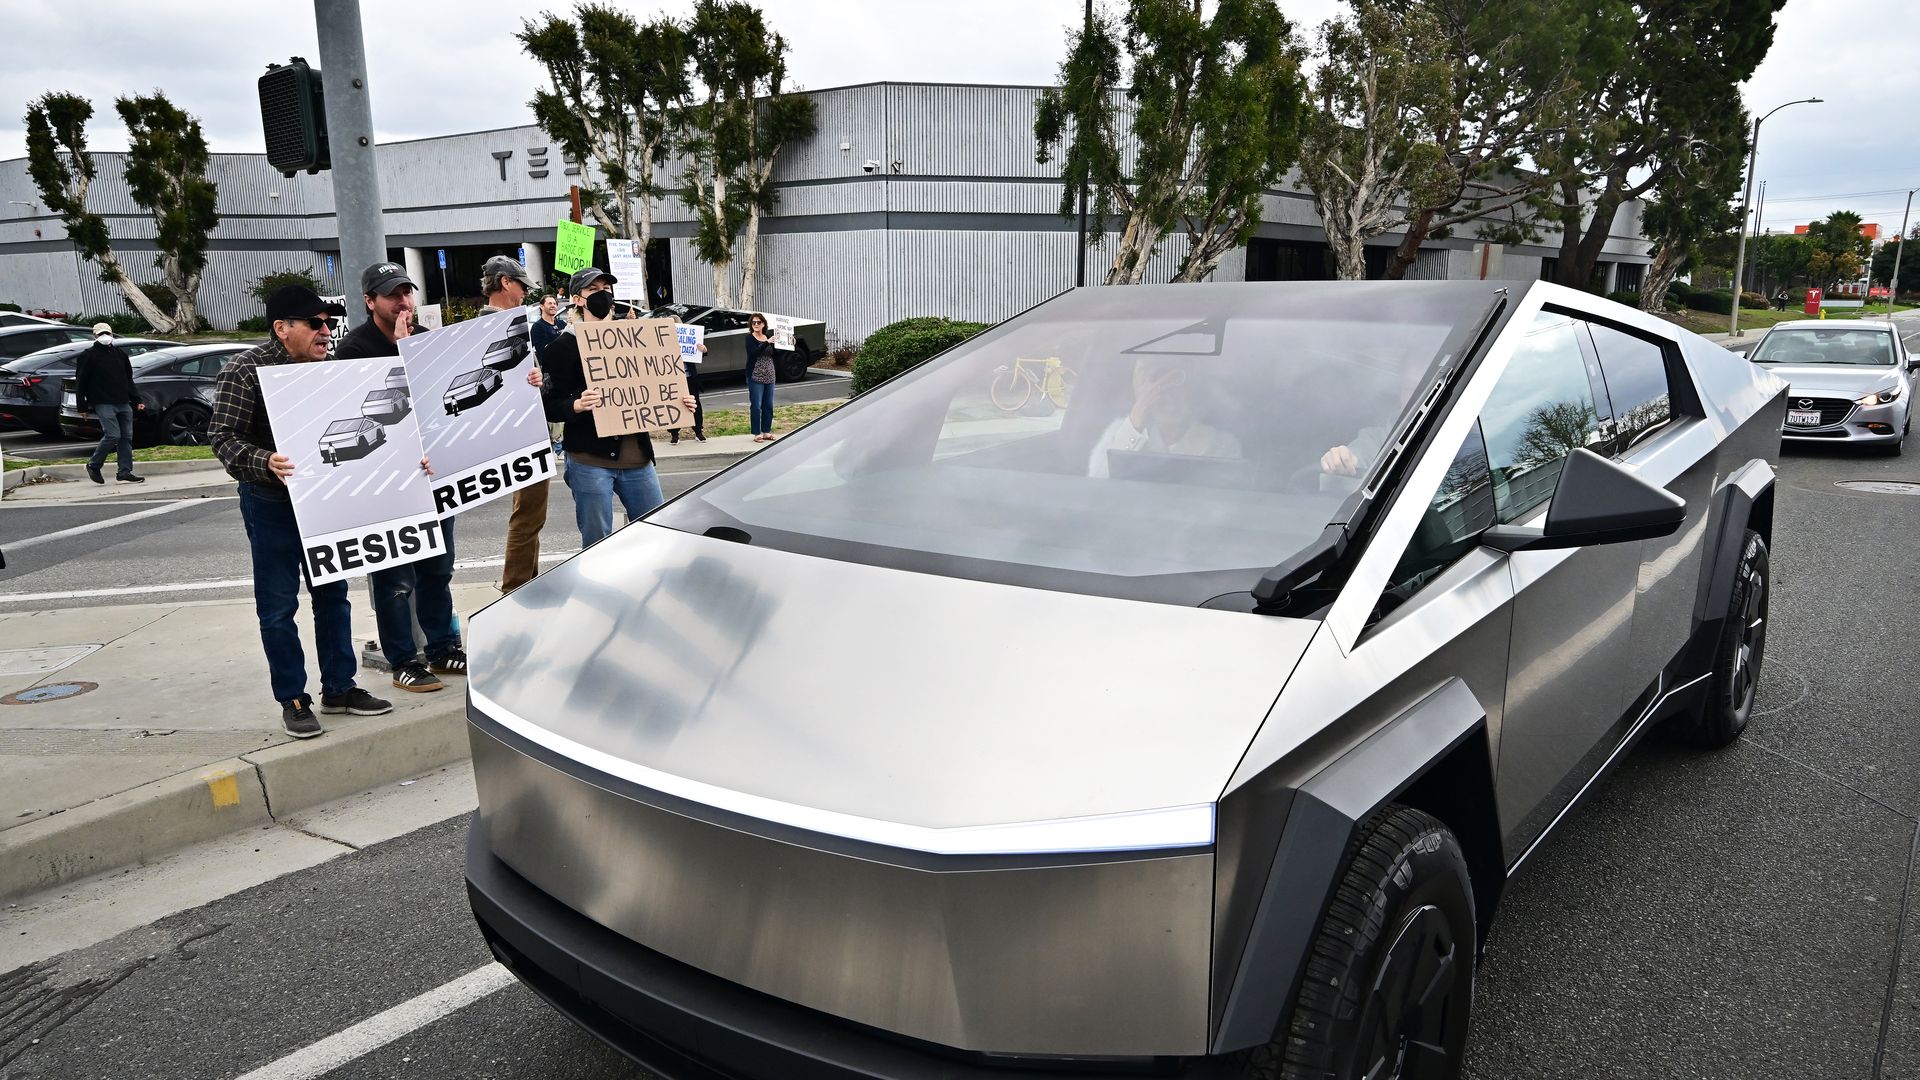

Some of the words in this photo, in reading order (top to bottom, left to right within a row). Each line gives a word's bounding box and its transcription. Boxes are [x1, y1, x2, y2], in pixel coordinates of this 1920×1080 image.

[584, 326, 647, 351] HONK
[655, 325, 670, 347] IF
[677, 327, 687, 335] USK
[690, 328, 696, 336] IS
[678, 335, 697, 345] ALING
[585, 356, 640, 382] ELON
[644, 354, 686, 376] MUSK
[659, 383, 678, 401] BE
[622, 404, 681, 429] FIRED
[1790, 415, 1819, 424] 7UTW197
[433, 447, 552, 513] RESIST
[307, 520, 439, 578] RESIST
